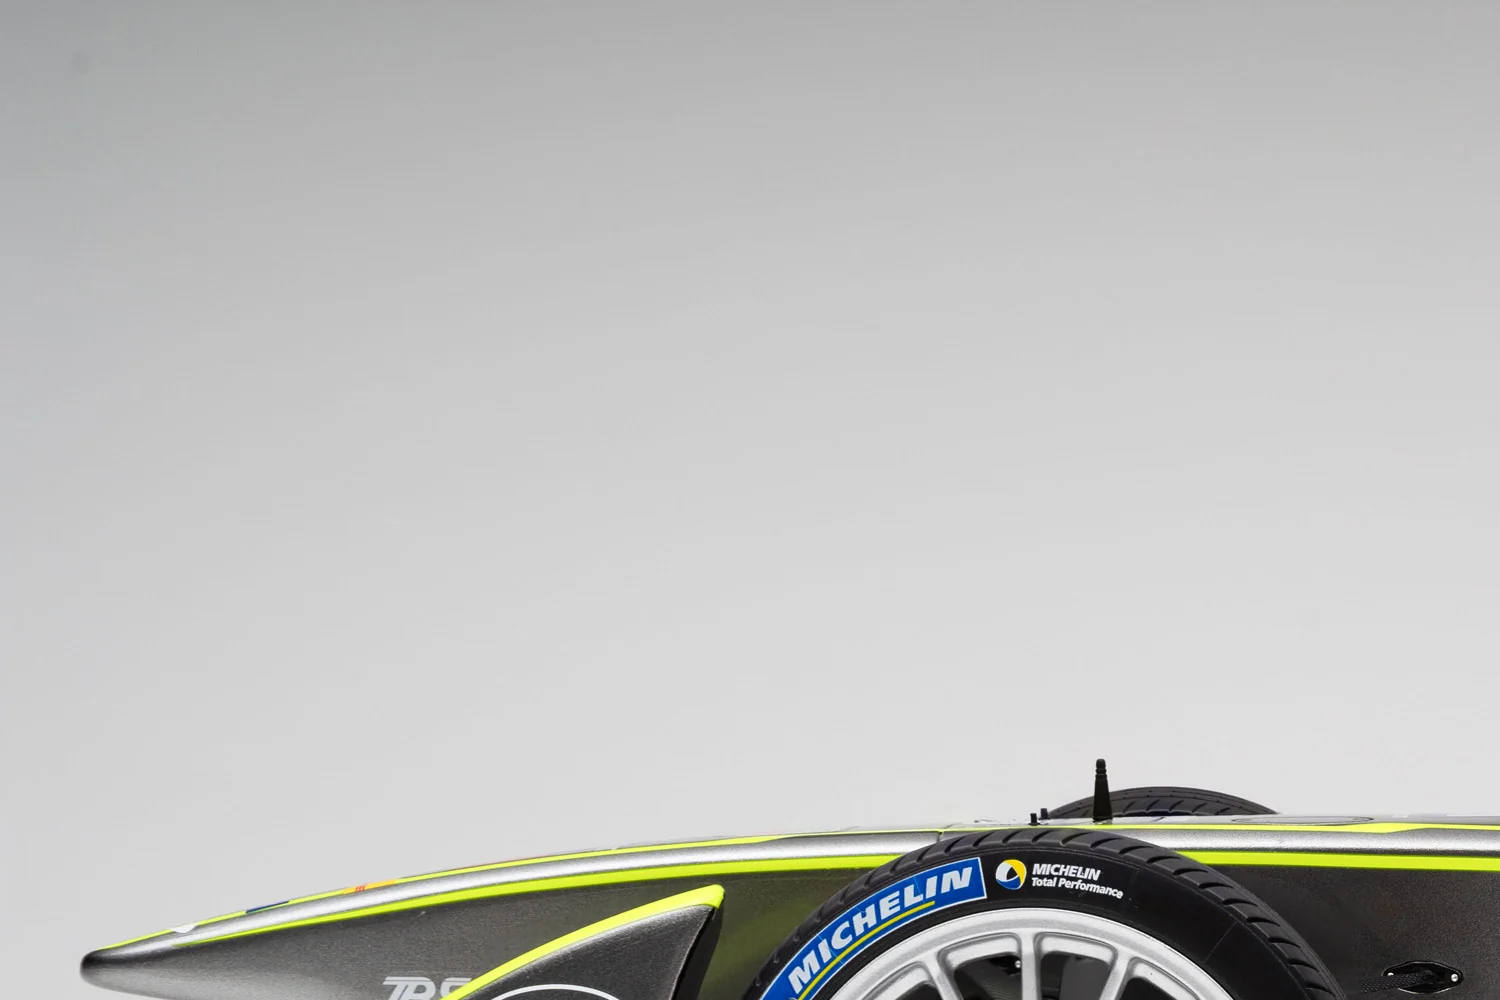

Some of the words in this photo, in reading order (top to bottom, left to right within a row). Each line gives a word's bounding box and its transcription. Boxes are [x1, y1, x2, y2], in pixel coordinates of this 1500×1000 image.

[1031, 863, 1102, 881] MICHELIN
[1031, 876, 1057, 888] Total
[1058, 877, 1124, 899] Performance
[787, 866, 974, 995] MICHELIN
